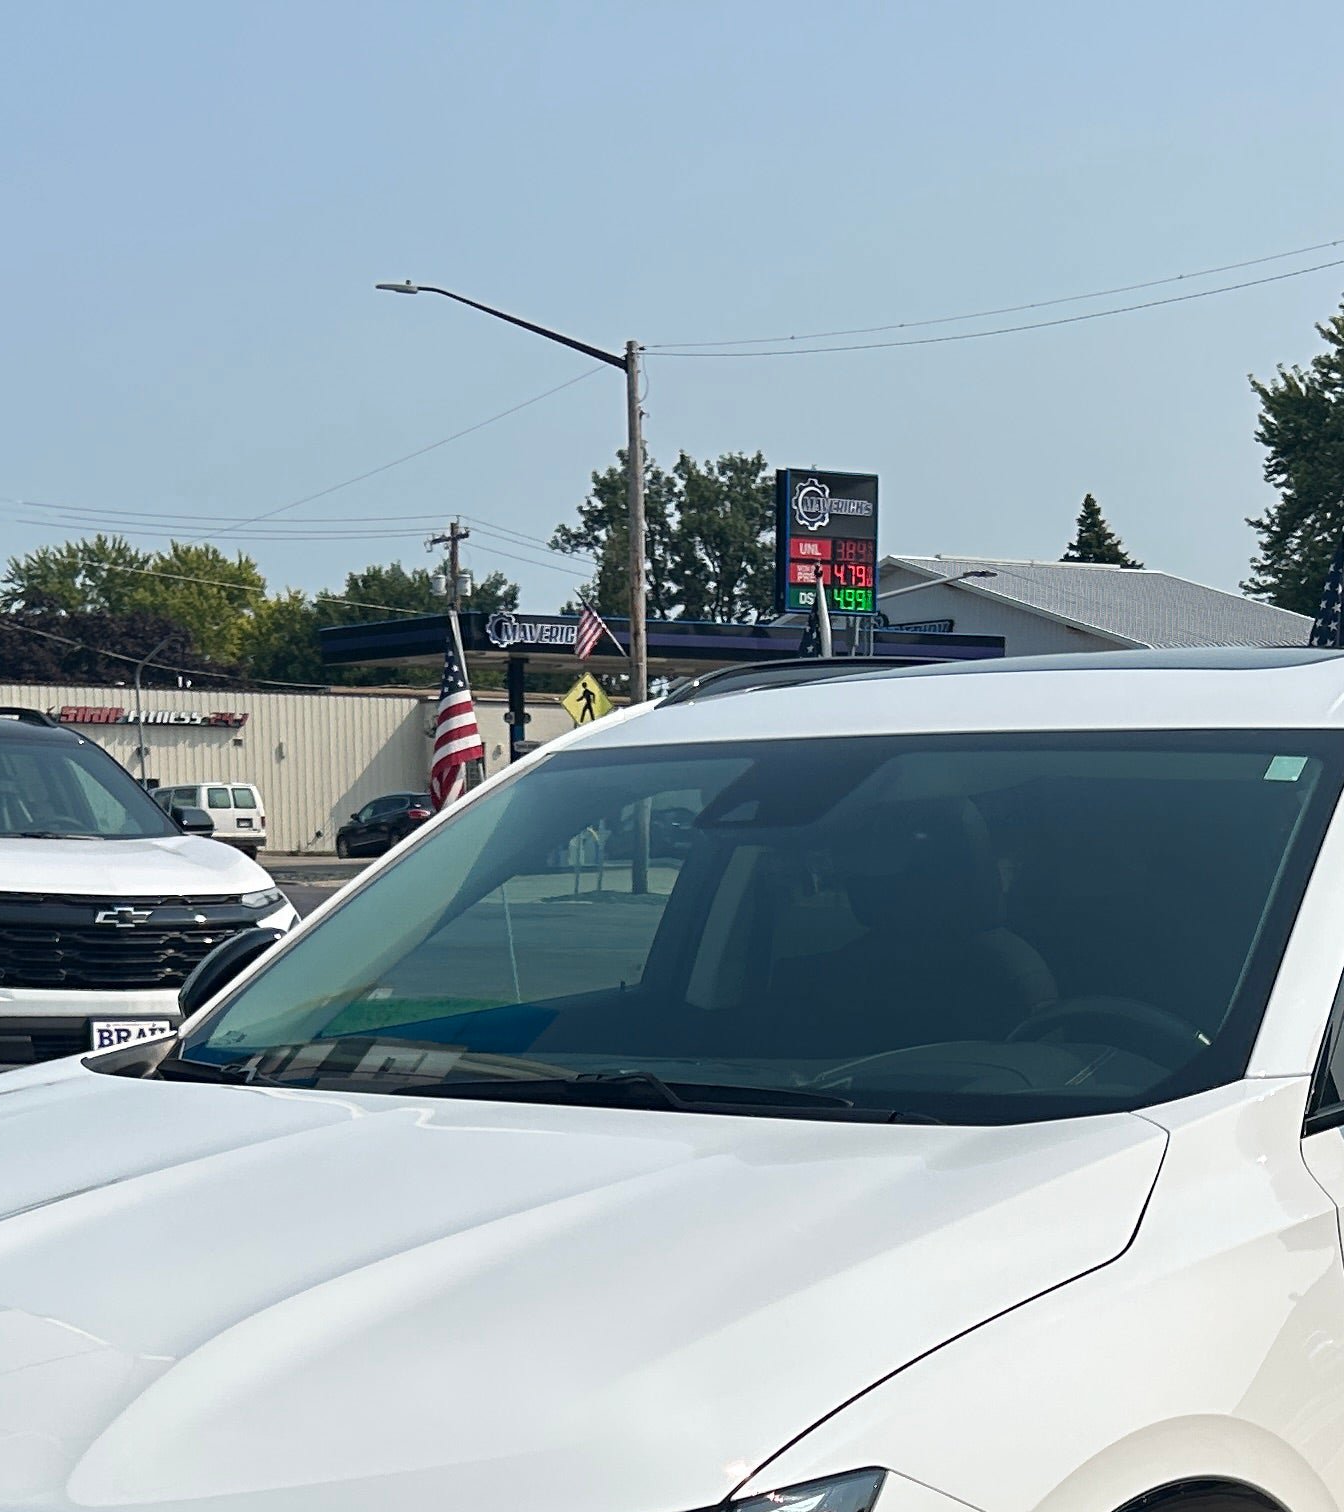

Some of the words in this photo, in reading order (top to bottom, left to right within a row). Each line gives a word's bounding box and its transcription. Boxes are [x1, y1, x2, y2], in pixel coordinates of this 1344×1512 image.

[799, 543, 821, 556] UNL
[799, 592, 816, 605] DS
[502, 622, 577, 645] MAVERIC
